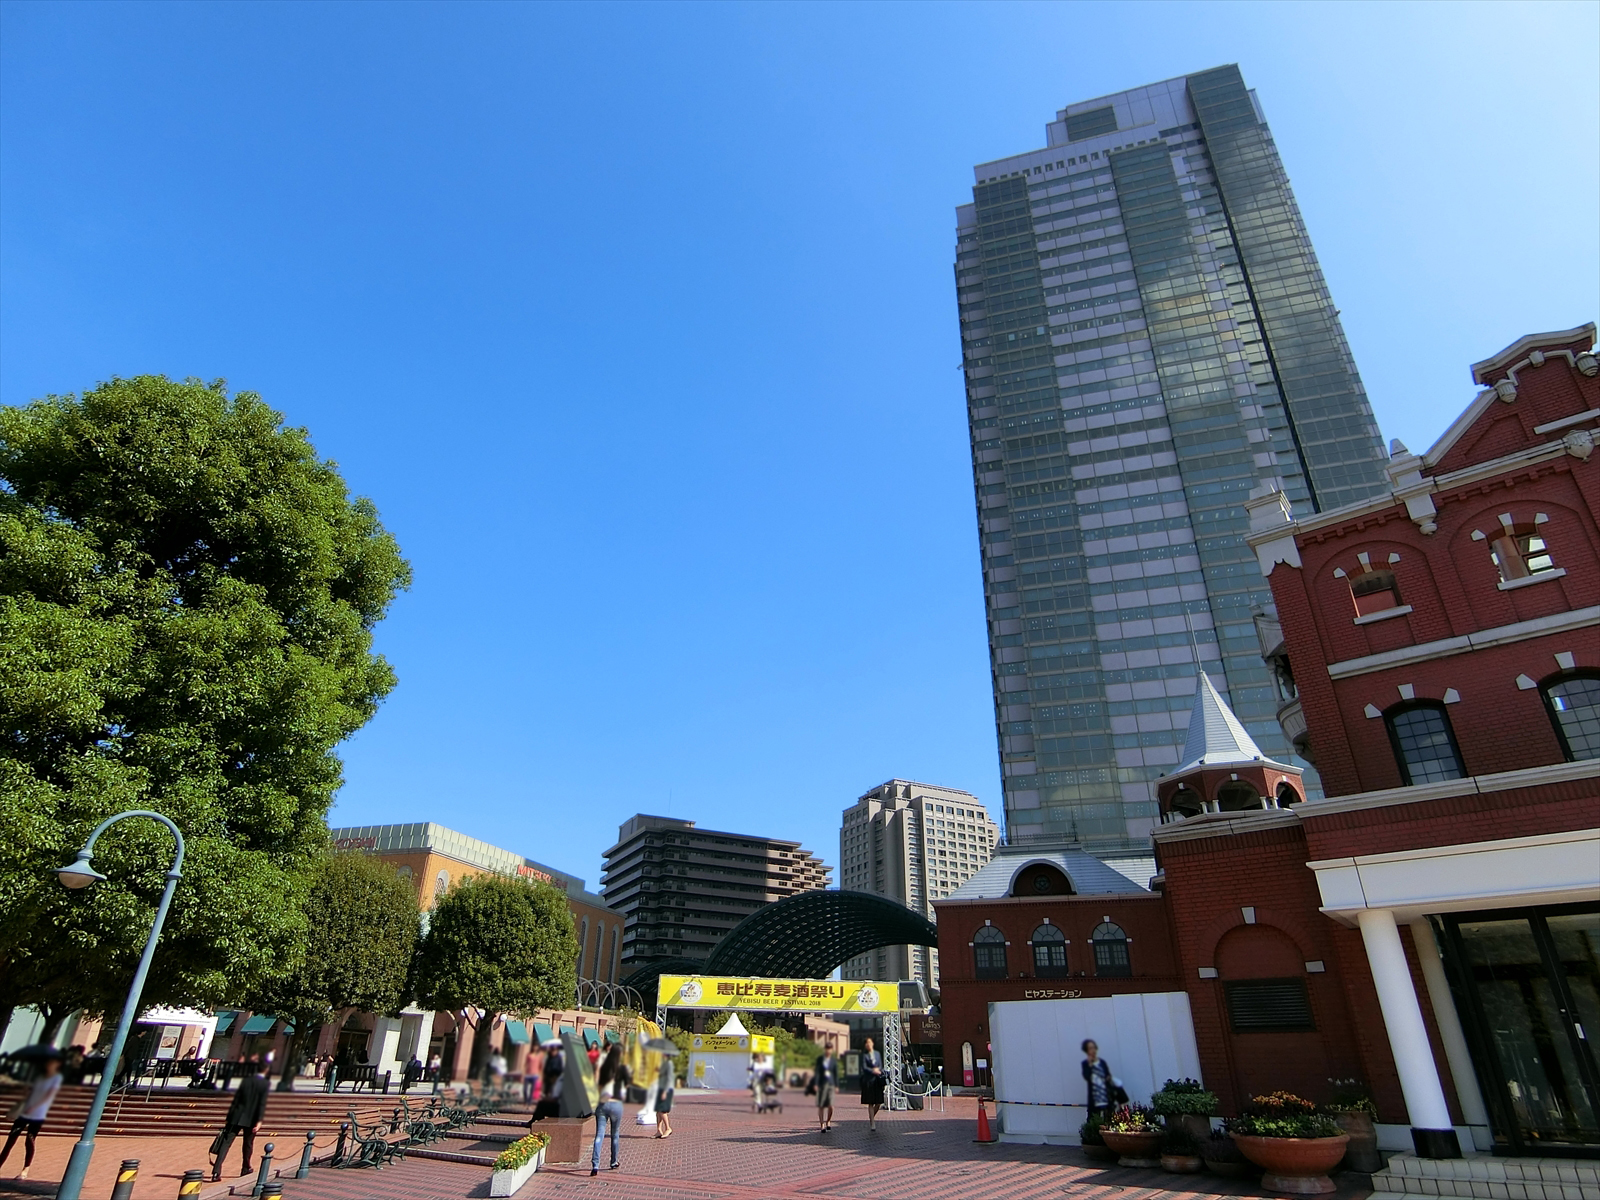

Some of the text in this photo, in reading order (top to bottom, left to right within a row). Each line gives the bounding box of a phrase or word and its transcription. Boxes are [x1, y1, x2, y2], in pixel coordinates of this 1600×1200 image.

[716, 982, 844, 998] 恵比寿麦酒祭り
[739, 997, 761, 1005] YEBISU
[763, 998, 780, 1006] BEER
